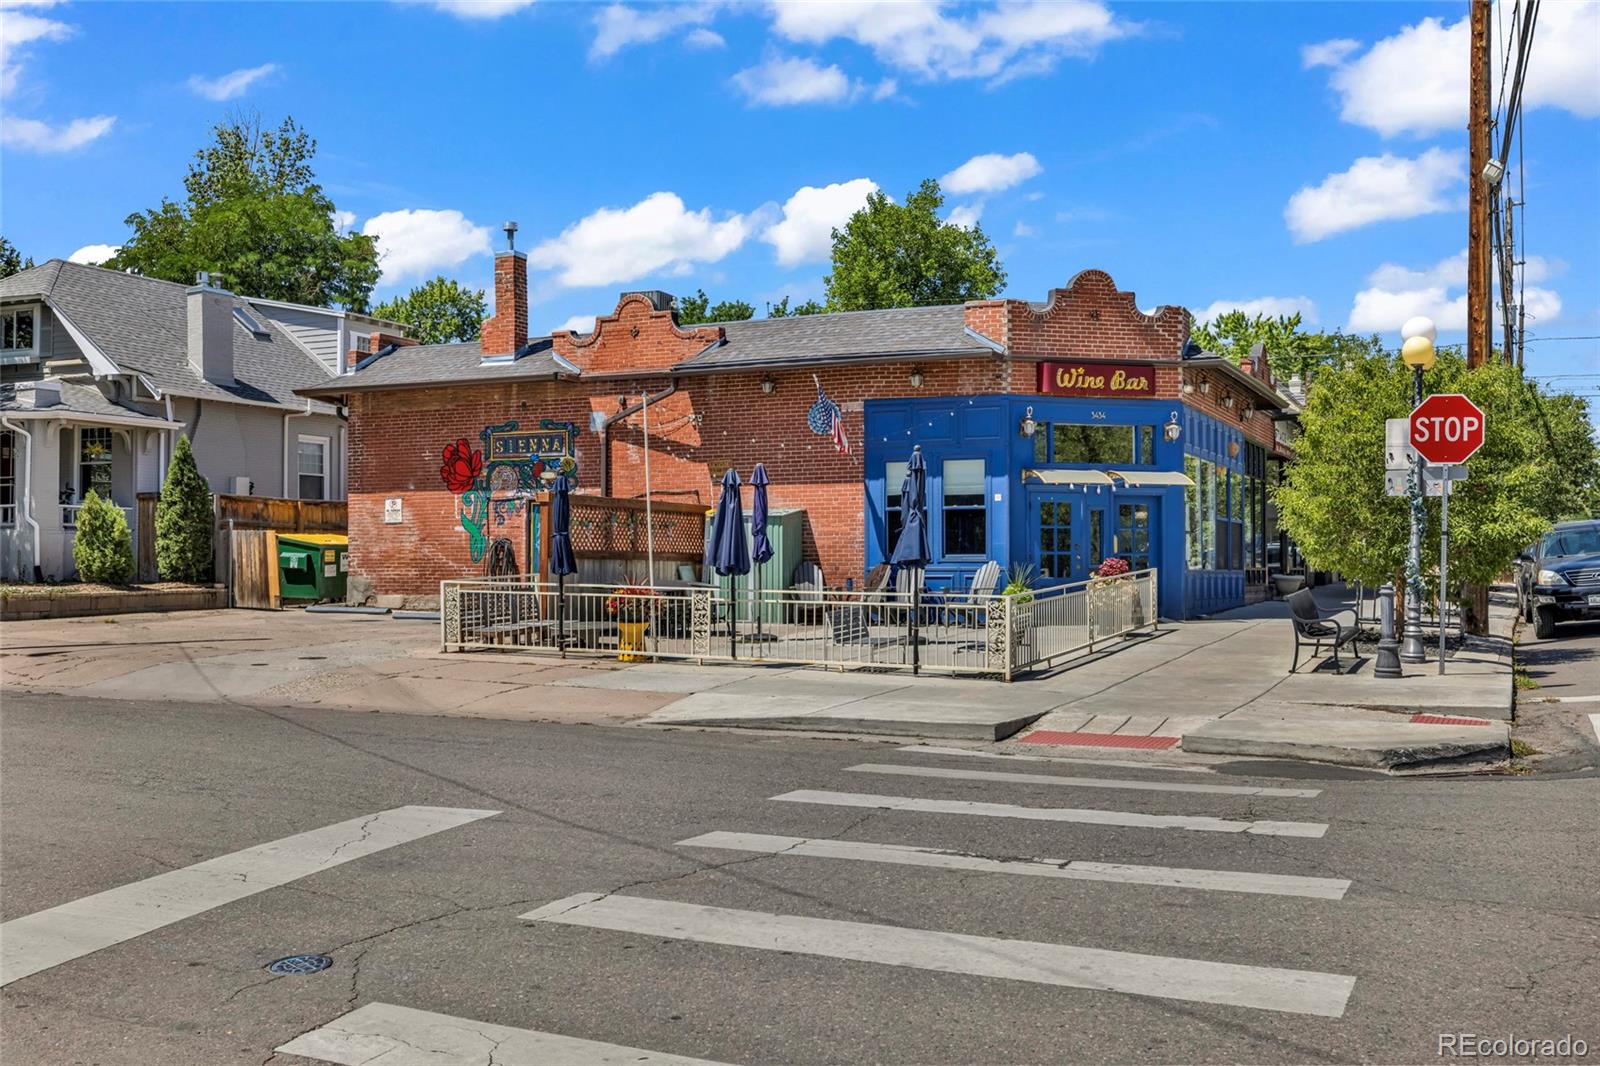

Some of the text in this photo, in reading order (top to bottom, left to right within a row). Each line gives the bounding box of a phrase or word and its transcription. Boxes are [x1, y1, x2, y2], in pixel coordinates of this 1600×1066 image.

[1056, 367, 1149, 391] Wine Bar
[1414, 416, 1479, 442] STOP
[495, 438, 560, 453] SIENNA
